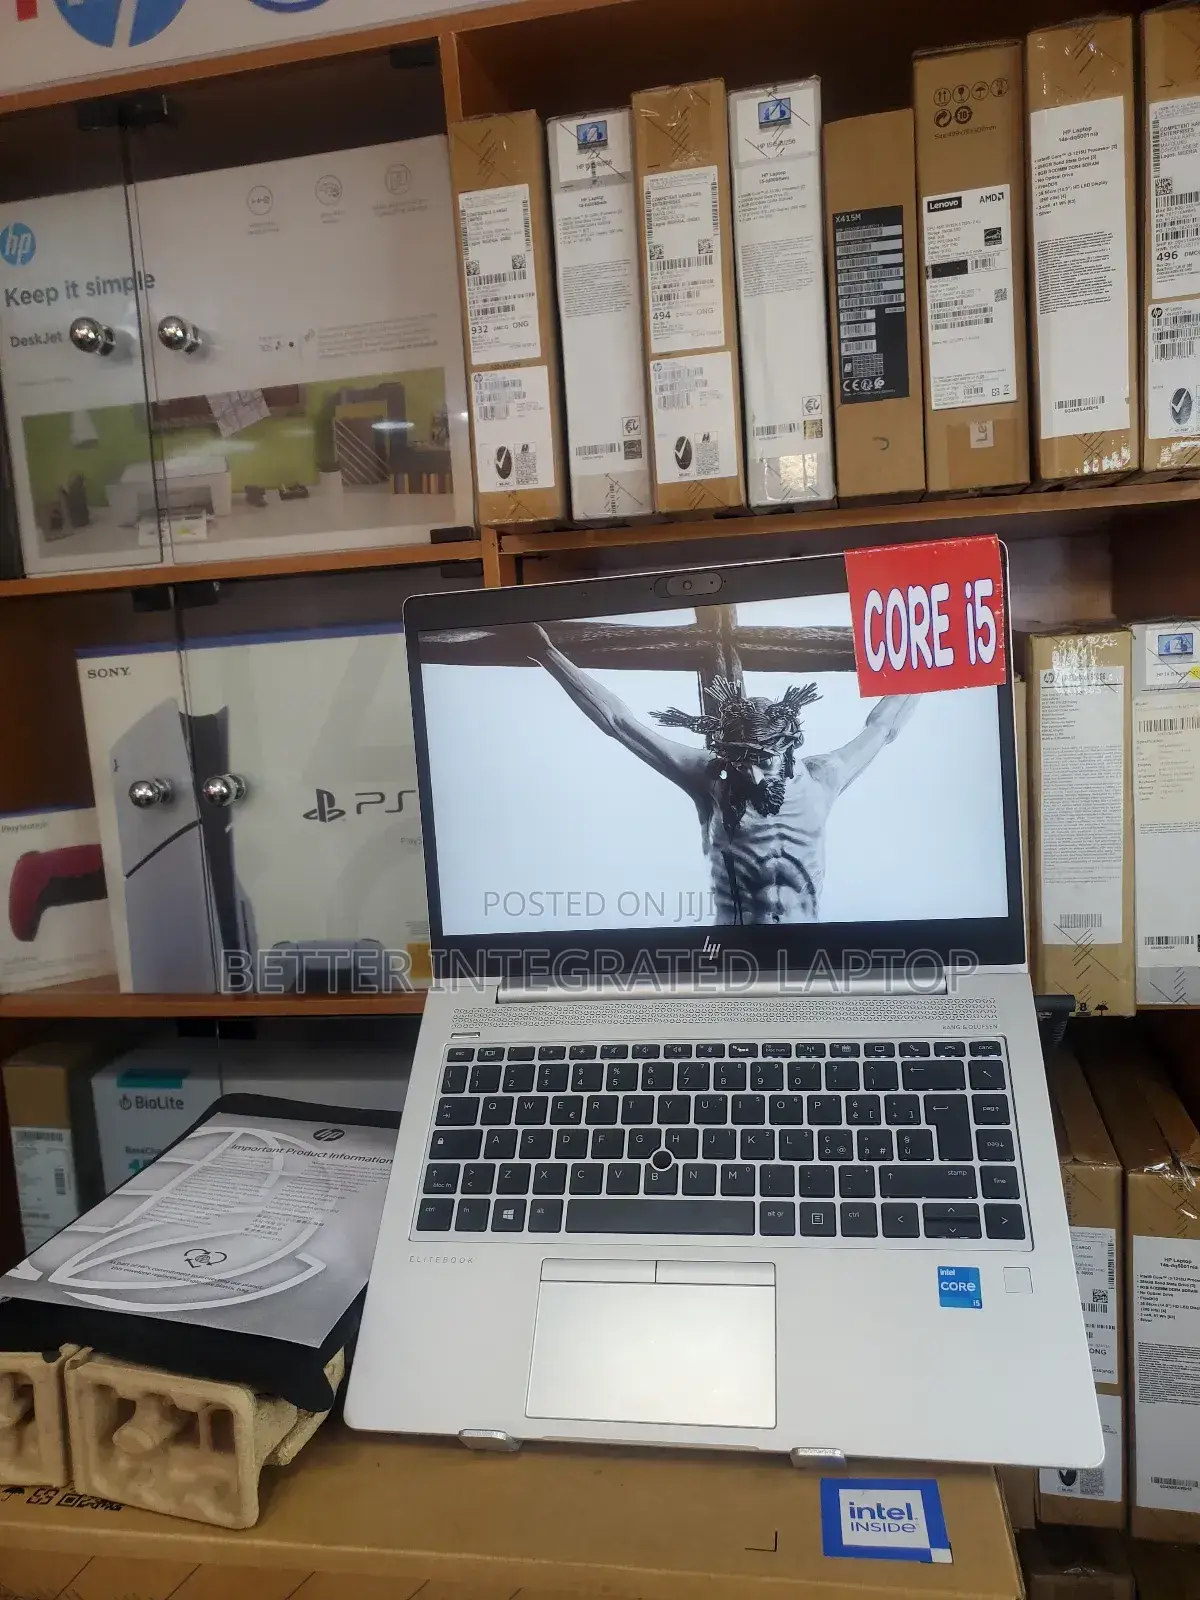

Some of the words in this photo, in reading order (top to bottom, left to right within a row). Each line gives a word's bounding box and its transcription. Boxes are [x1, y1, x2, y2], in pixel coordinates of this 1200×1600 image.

[1073, 126, 1093, 134] Laptop
[929, 198, 960, 210] Lenovo
[980, 193, 998, 204] AMD
[835, 213, 862, 223] X415M
[0, 222, 36, 266] hp
[1156, 250, 1179, 262] 496
[4, 285, 59, 307] Keep
[64, 280, 80, 299] it
[86, 270, 156, 296] simple
[652, 311, 671, 321] 494
[696, 307, 714, 316] ONG
[471, 324, 489, 335] 932
[512, 320, 529, 329] ONG
[10, 331, 64, 347] DeskJet
[864, 582, 954, 672] CORE
[965, 578, 997, 665] i5
[87, 666, 130, 679] SONY
[613, 1078, 618, 1086] 5
[135, 1096, 184, 1110] BioLite
[488, 1102, 497, 1111] Q
[523, 1102, 534, 1110] W
[557, 1102, 564, 1110] E
[593, 1101, 600, 1109] R
[628, 1101, 635, 1109] T
[665, 1101, 672, 1109] Y
[701, 1101, 709, 1109] U
[739, 1101, 742, 1109] I
[776, 1101, 785, 1109] O
[815, 1101, 821, 1109] P
[492, 1136, 500, 1144] A
[527, 1135, 534, 1144] S
[563, 1135, 570, 1143] D
[598, 1135, 605, 1143] F
[636, 1135, 644, 1143] G
[672, 1135, 680, 1143] H
[710, 1136, 716, 1144] J
[748, 1136, 756, 1144] K
[786, 1136, 793, 1145] L
[231, 1143, 286, 1155] Important
[286, 1147, 328, 1159] Product
[328, 1151, 393, 1165] Information
[504, 1171, 512, 1179] Z
[540, 1171, 548, 1179] X
[577, 1171, 585, 1179] C
[614, 1170, 623, 1179] V
[652, 1173, 659, 1181] B
[689, 1171, 698, 1179] N
[728, 1171, 737, 1180] M
[947, 1170, 968, 1178] stamp
[409, 1255, 474, 1264] ELITEBOOK
[1173, 1257, 1193, 1265] Laptop
[940, 1268, 956, 1276] intel
[1088, 1348, 1107, 1356] ONG
[849, 1501, 917, 1520] intel
